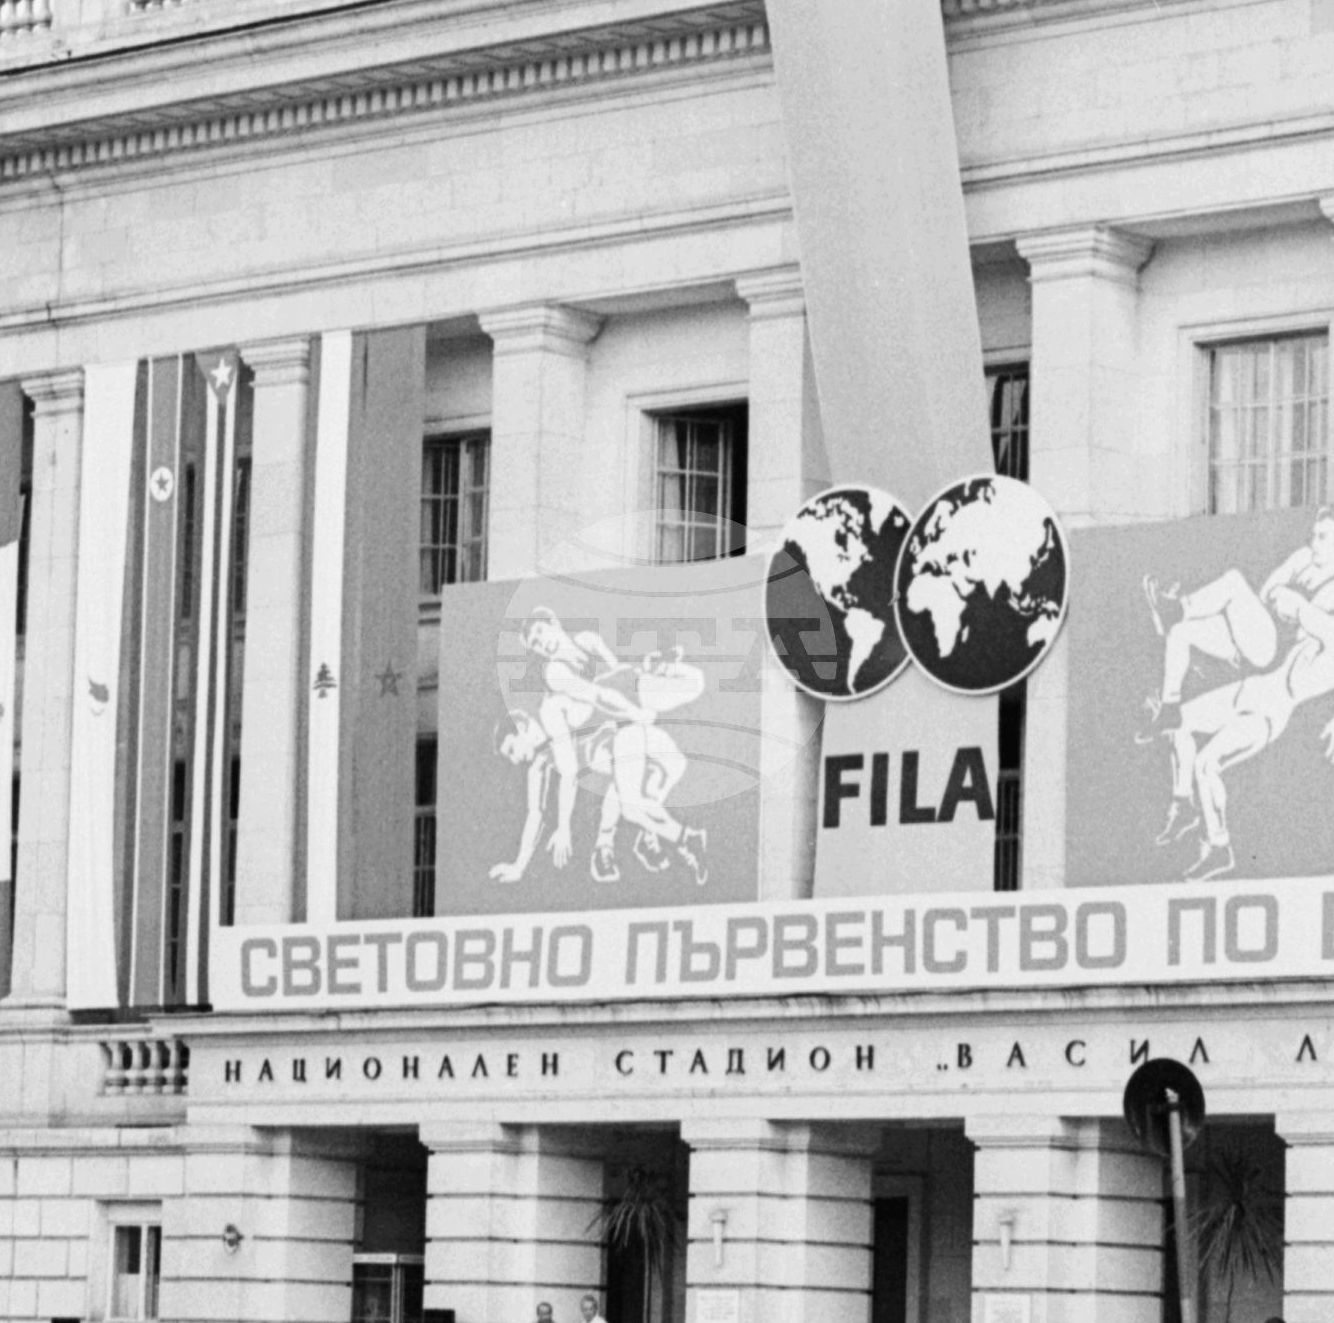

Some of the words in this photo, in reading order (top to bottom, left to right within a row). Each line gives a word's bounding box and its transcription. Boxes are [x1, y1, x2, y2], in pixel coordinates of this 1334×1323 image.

[823, 745, 996, 829] FILA
[239, 924, 595, 999] СВЕТОВНО
[624, 900, 1128, 985] ПЪРВЕНСТВО
[1166, 892, 1280, 967] ПО
[224, 1052, 560, 1083] НАЦИОНАЛЕН
[614, 1044, 876, 1075] СТАДИОН
